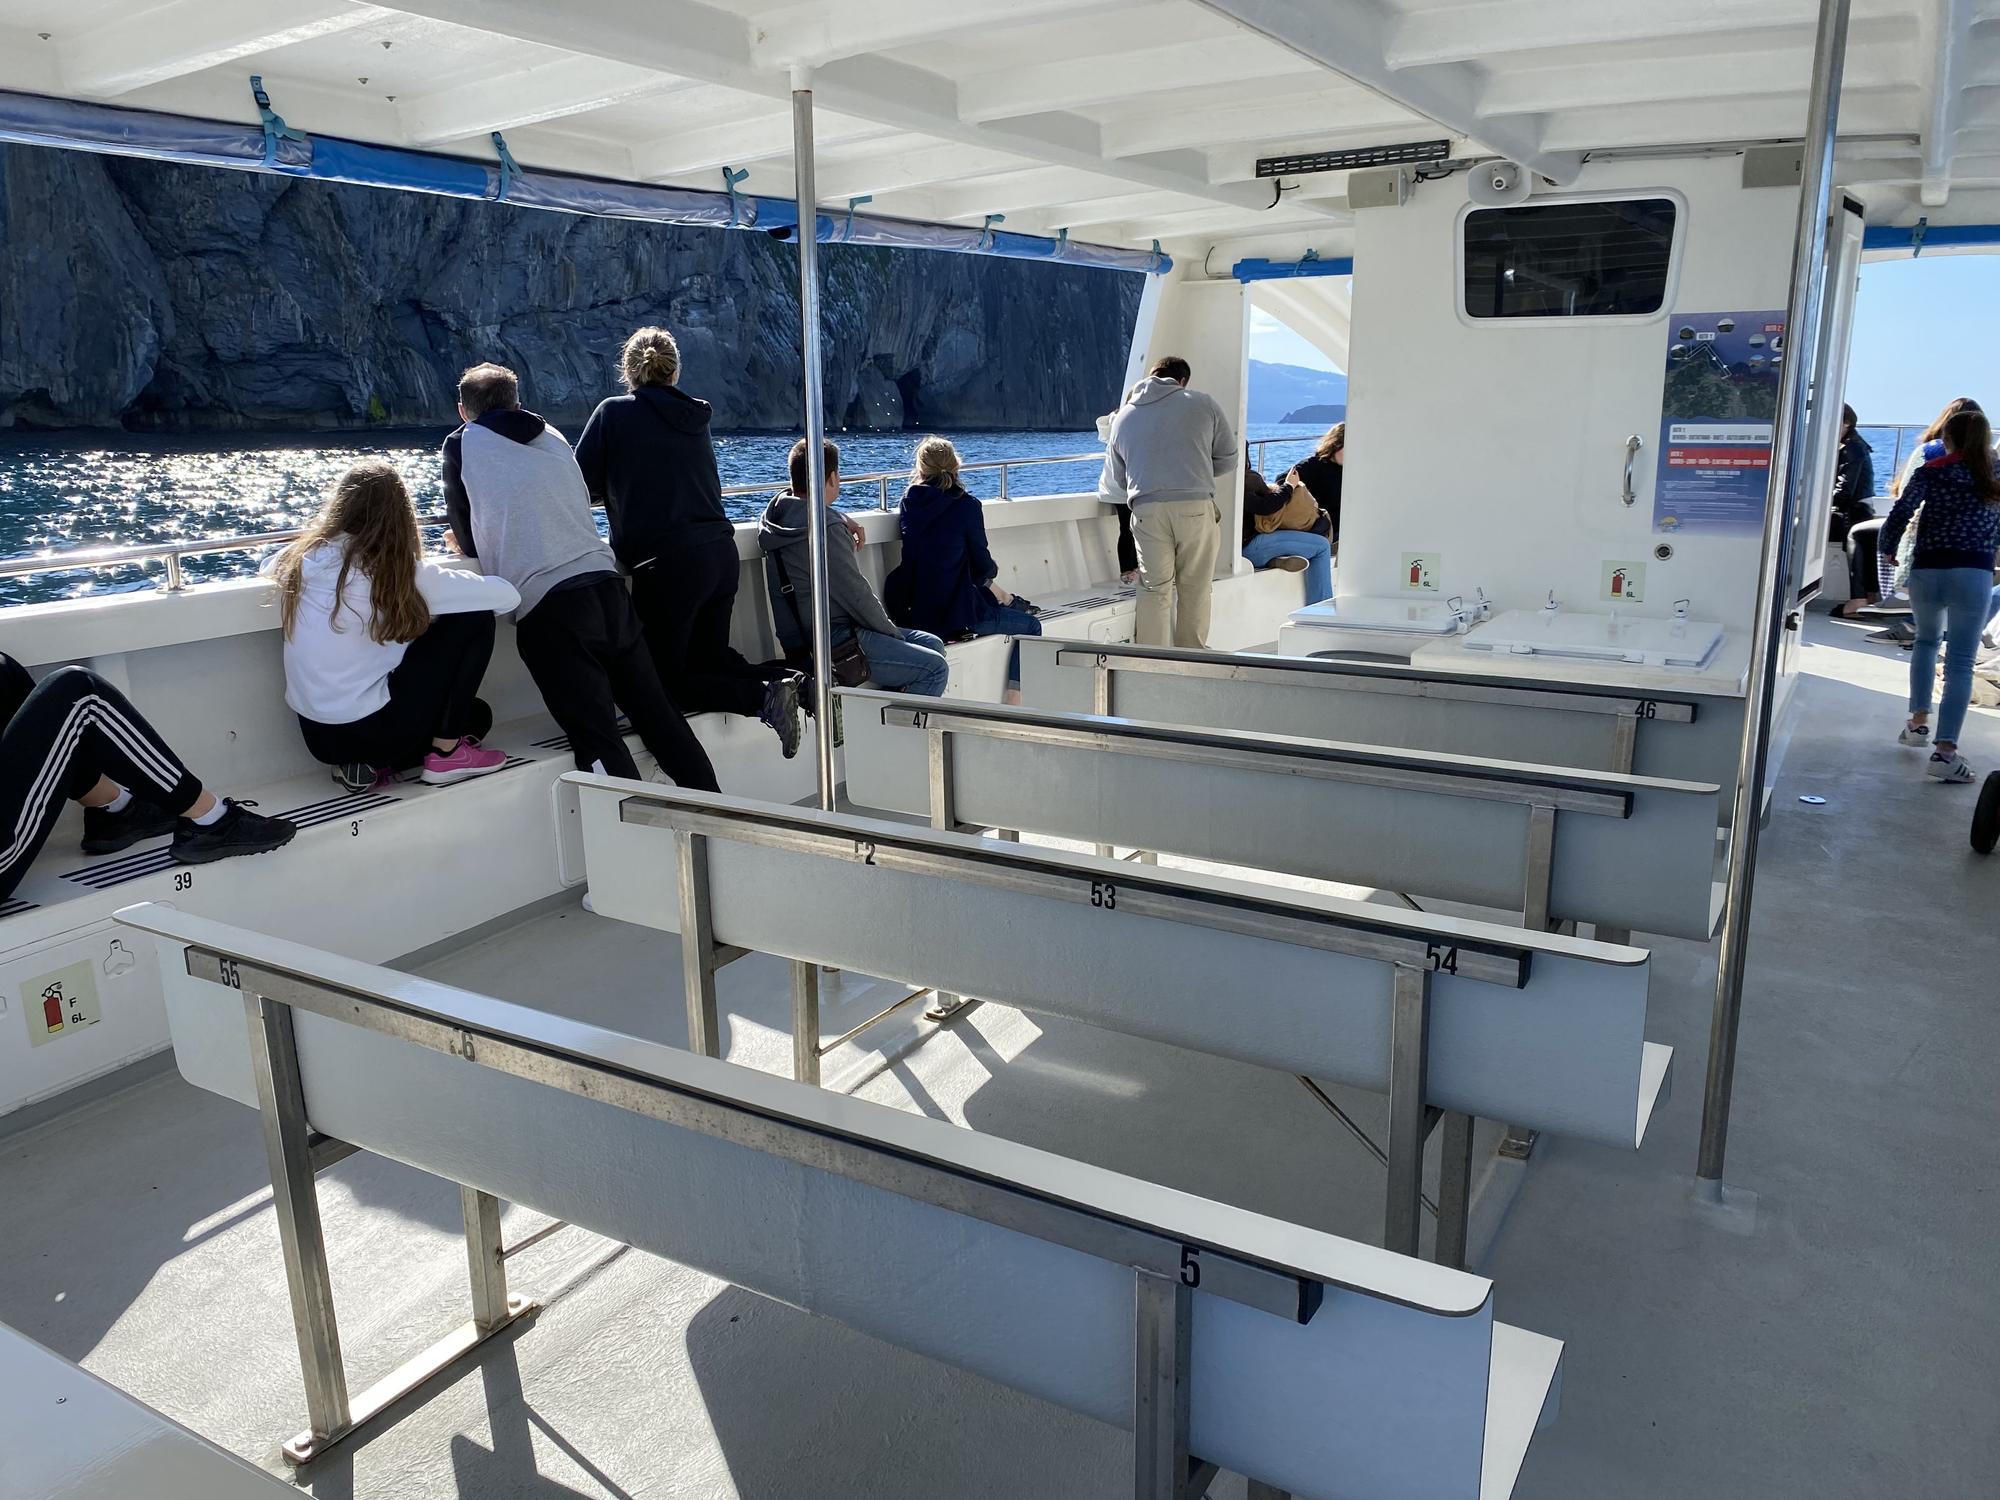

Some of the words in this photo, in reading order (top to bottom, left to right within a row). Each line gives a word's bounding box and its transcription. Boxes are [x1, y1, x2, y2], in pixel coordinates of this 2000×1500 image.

[912, 711, 929, 729] 47
[1634, 700, 1657, 720] 46
[174, 871, 192, 891] 39
[1090, 881, 1116, 910] 53
[1426, 942, 1458, 976] 54
[219, 957, 241, 990] 55
[69, 997, 78, 1008] F
[71, 1012, 87, 1024] 6L
